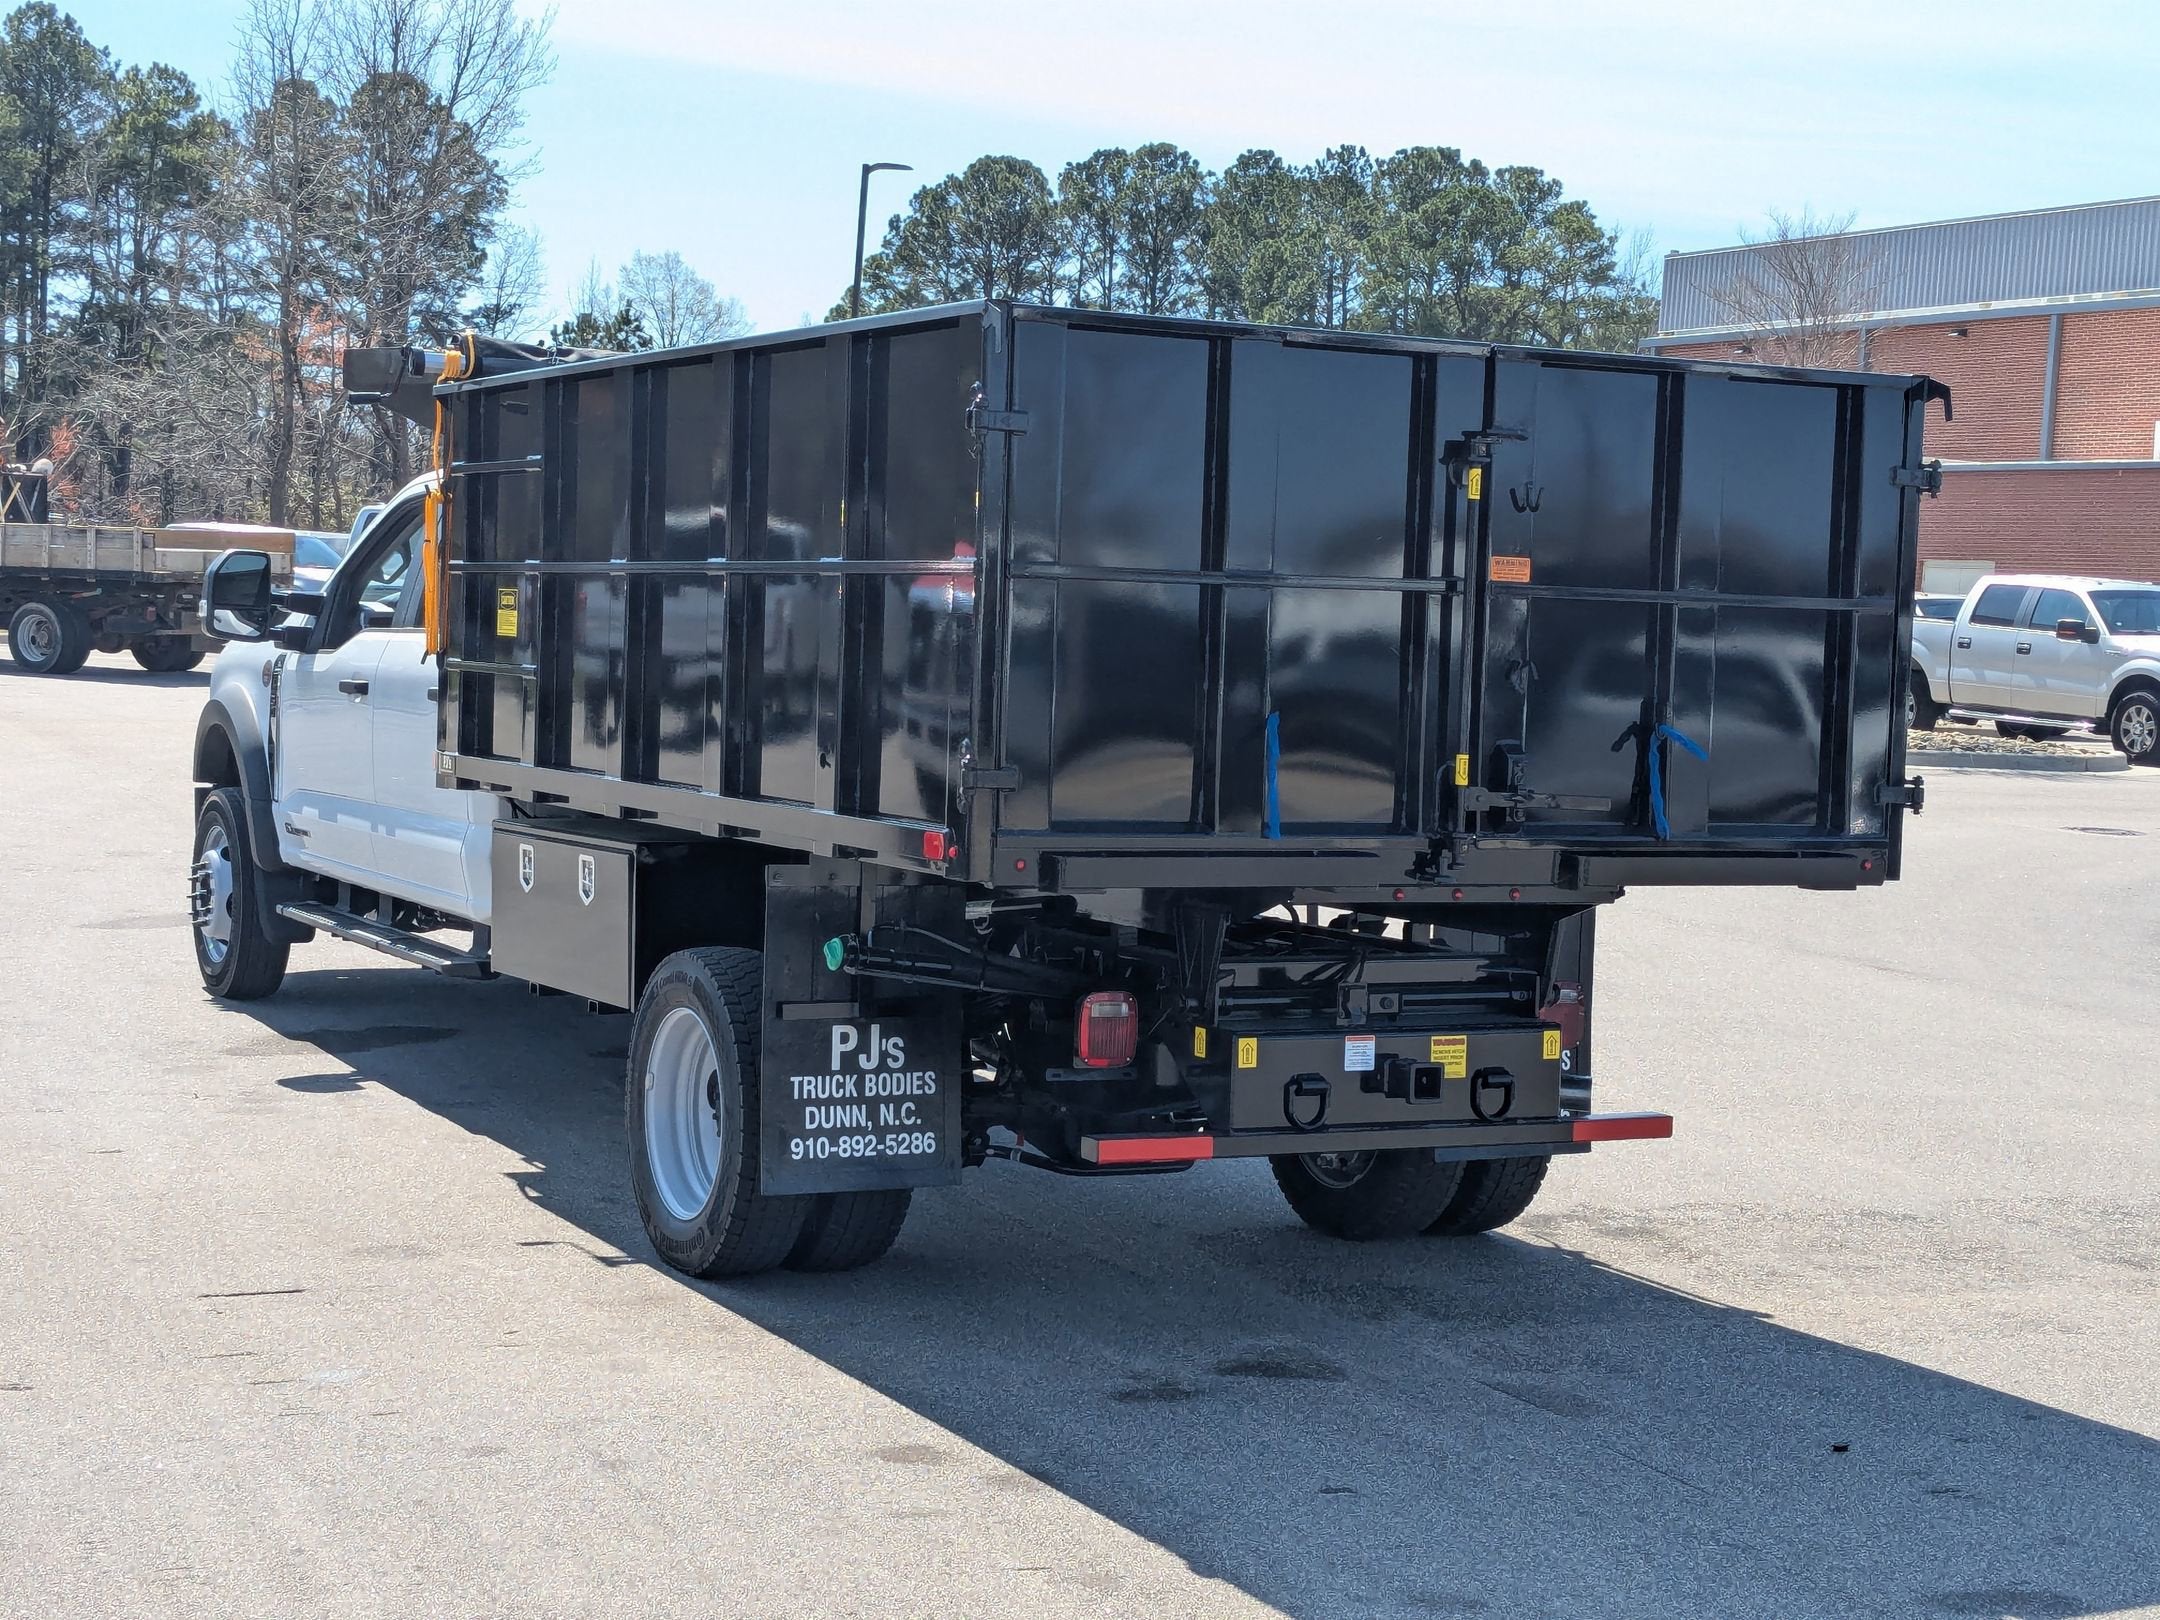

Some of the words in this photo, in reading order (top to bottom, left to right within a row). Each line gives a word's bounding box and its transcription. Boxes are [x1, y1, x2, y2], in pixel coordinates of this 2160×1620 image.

[831, 1024, 905, 1071] PJ's
[790, 1074, 858, 1099] TRUCK
[865, 1071, 936, 1097] BODIES
[805, 1104, 872, 1131] DUNN,
[879, 1102, 922, 1126] N.C.
[790, 1132, 936, 1160] 910-892-5286
